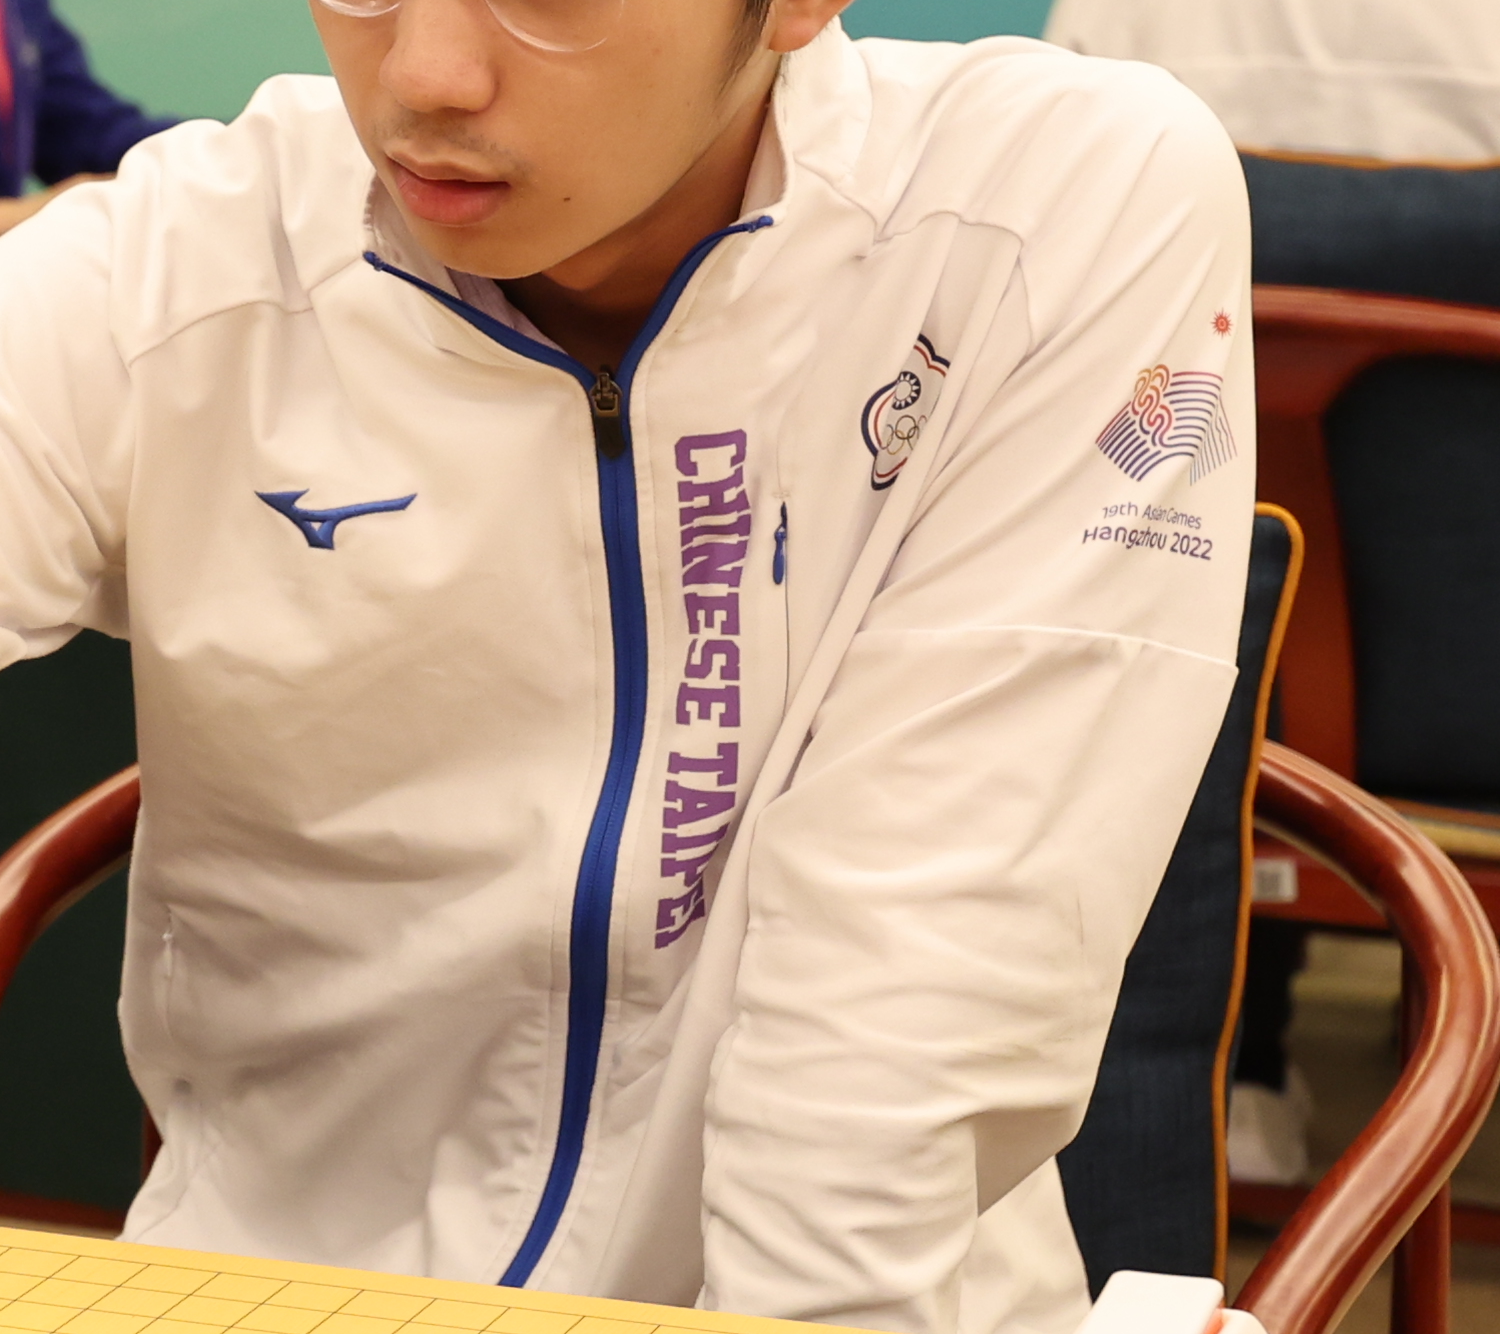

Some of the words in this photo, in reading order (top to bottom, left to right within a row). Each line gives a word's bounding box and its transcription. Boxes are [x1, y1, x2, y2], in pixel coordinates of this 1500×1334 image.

[1082, 526, 1167, 550] Hangzhou
[1170, 532, 1213, 561] 2022
[1102, 502, 1138, 519] 19th
[1142, 504, 1166, 522] Asian
[1167, 508, 1202, 530] Games
[674, 428, 751, 727] CHINESE
[655, 742, 739, 949] TAIPEI
